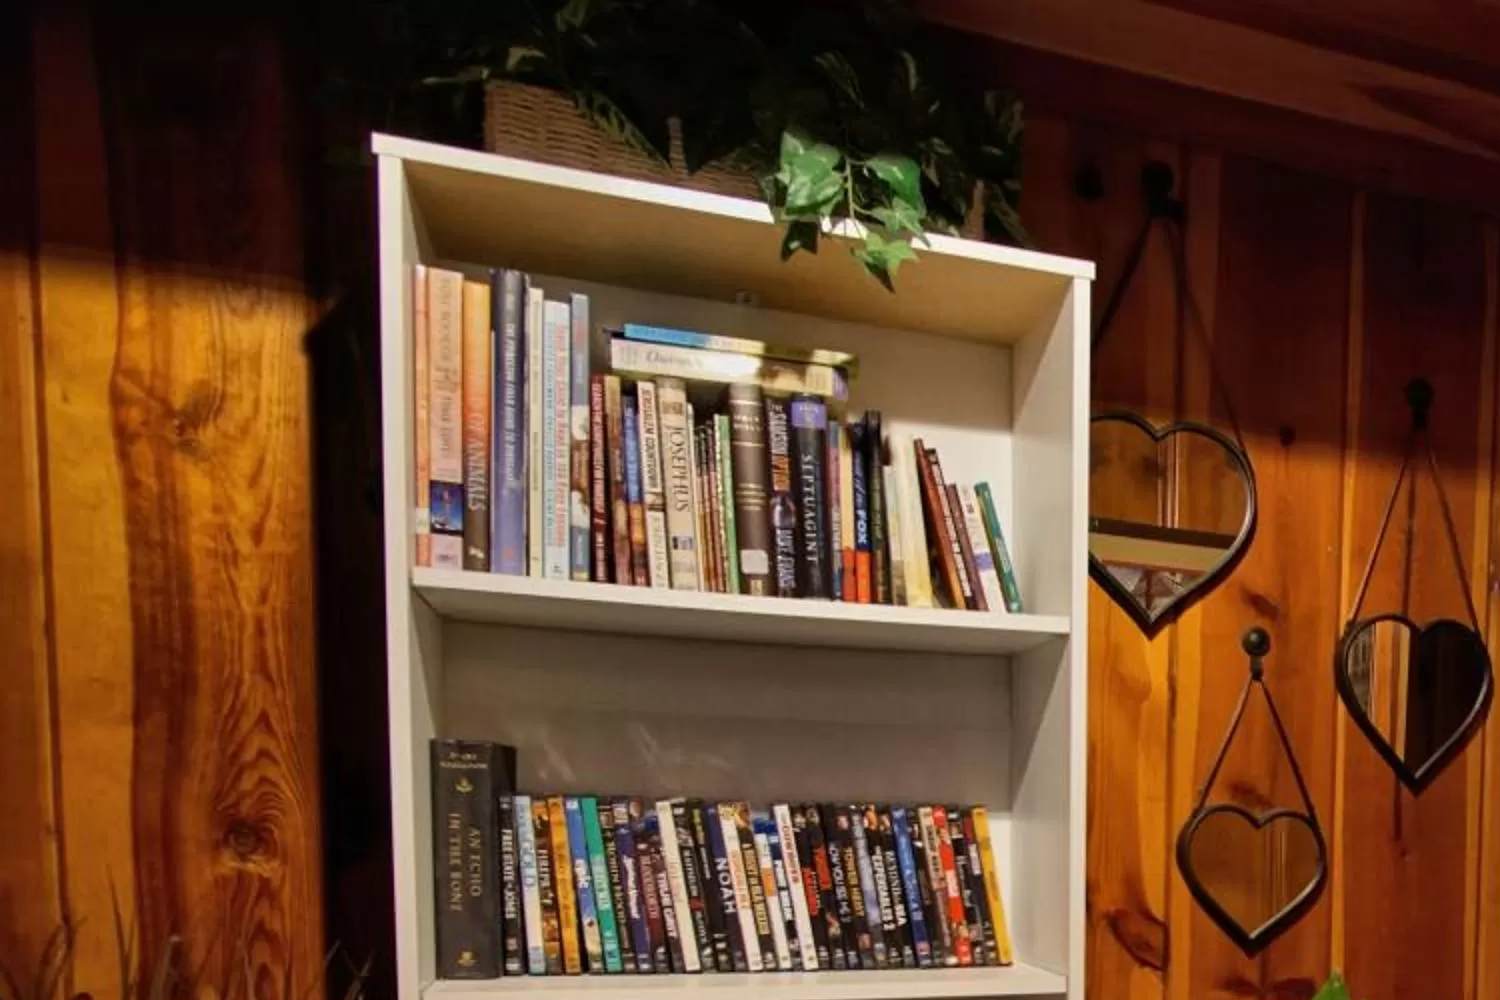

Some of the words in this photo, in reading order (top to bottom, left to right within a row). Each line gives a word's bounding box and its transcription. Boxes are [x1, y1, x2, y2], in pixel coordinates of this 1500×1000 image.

[641, 389, 654, 434] JERUSALEM
[769, 411, 787, 453] SAMSON
[467, 437, 485, 511] ANIMALS
[644, 436, 658, 489] COUNTDOWN
[666, 424, 690, 513] JOSEPHUS
[801, 452, 818, 565] SEPTUAGINT
[856, 508, 867, 544] FOX
[448, 836, 460, 864] THE
[468, 827, 479, 847] AN
[500, 828, 513, 851] FREE
[469, 855, 481, 896] ECHO
[502, 853, 514, 881] STATE
[714, 856, 736, 914] NOAH
[842, 846, 858, 886] TOWER
[503, 887, 516, 918] JONES
[656, 871, 671, 907] TRUE
[662, 907, 677, 939] GRIT
